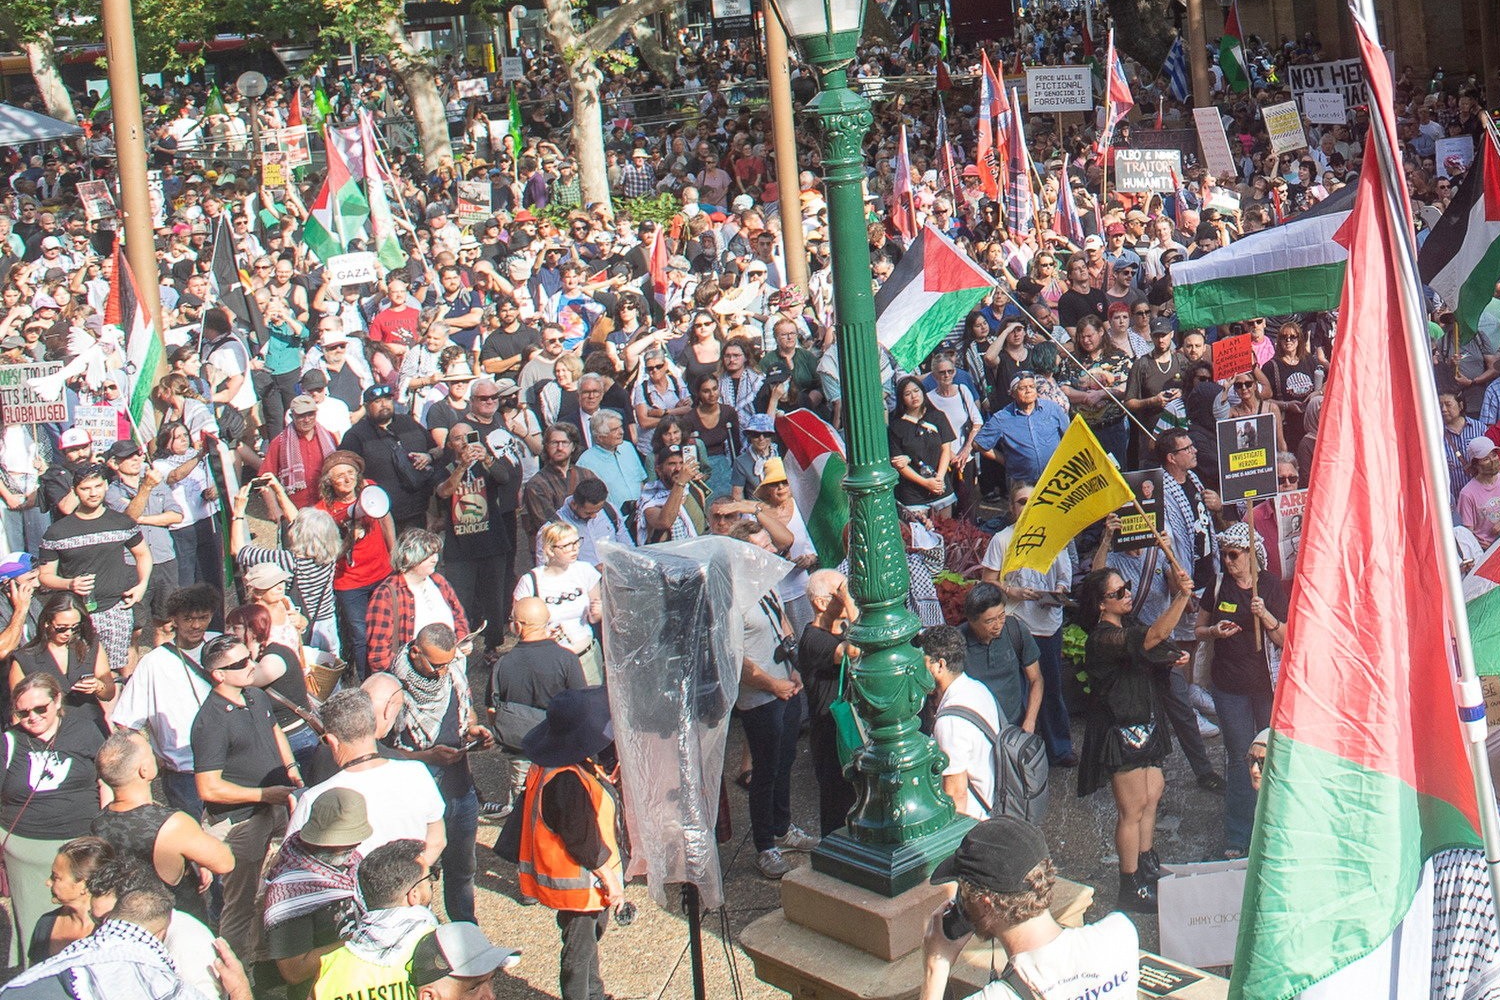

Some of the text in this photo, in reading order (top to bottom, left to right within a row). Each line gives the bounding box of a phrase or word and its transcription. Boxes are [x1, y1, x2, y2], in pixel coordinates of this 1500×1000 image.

[1291, 66, 1324, 90] NOT
[1035, 81, 1083, 90] FICTIONAL
[1115, 149, 1142, 161] ALBO
[1124, 160, 1175, 174] TRAITORS
[1122, 177, 1174, 189] HUMANITY
[336, 268, 370, 280] GAZA
[1229, 338, 1240, 347] AM
[1, 388, 20, 406] ITS
[1232, 450, 1264, 462] INVESTIGATE
[1238, 460, 1258, 468] HERZOG
[1122, 516, 1143, 524] WANTED
[454, 520, 490, 536] GENOCIDE
[1188, 914, 1212, 926] JIMMY
